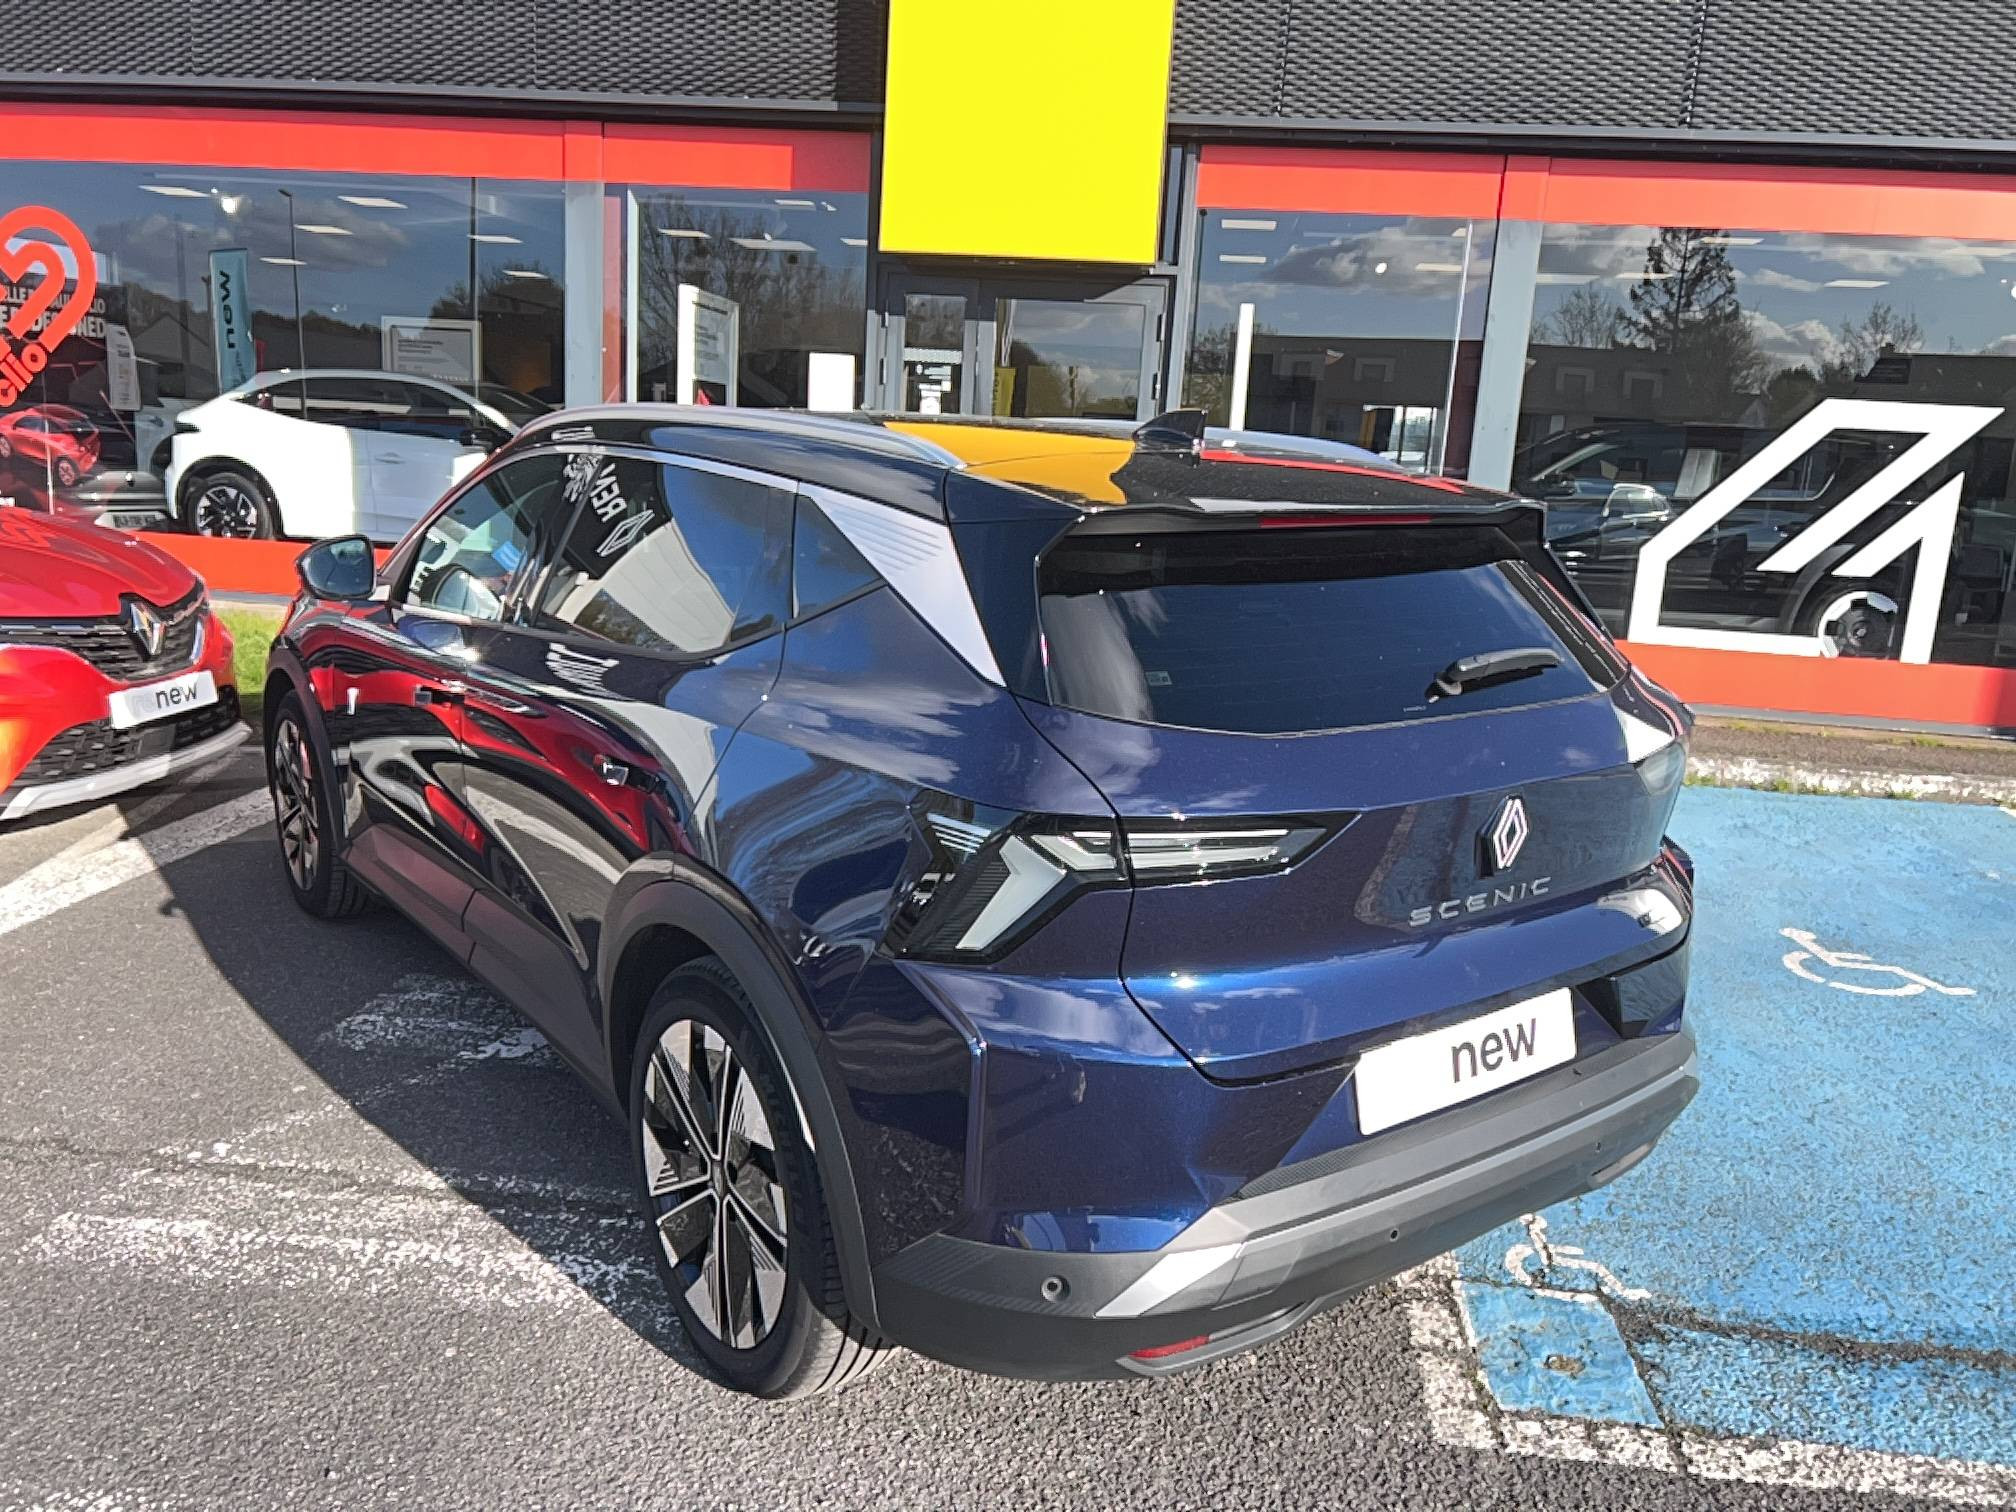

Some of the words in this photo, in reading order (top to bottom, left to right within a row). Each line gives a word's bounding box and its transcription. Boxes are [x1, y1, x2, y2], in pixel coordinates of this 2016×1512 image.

[155, 682, 198, 709] new
[1408, 876, 1552, 928] SCENIC
[1451, 1017, 1537, 1084] new
